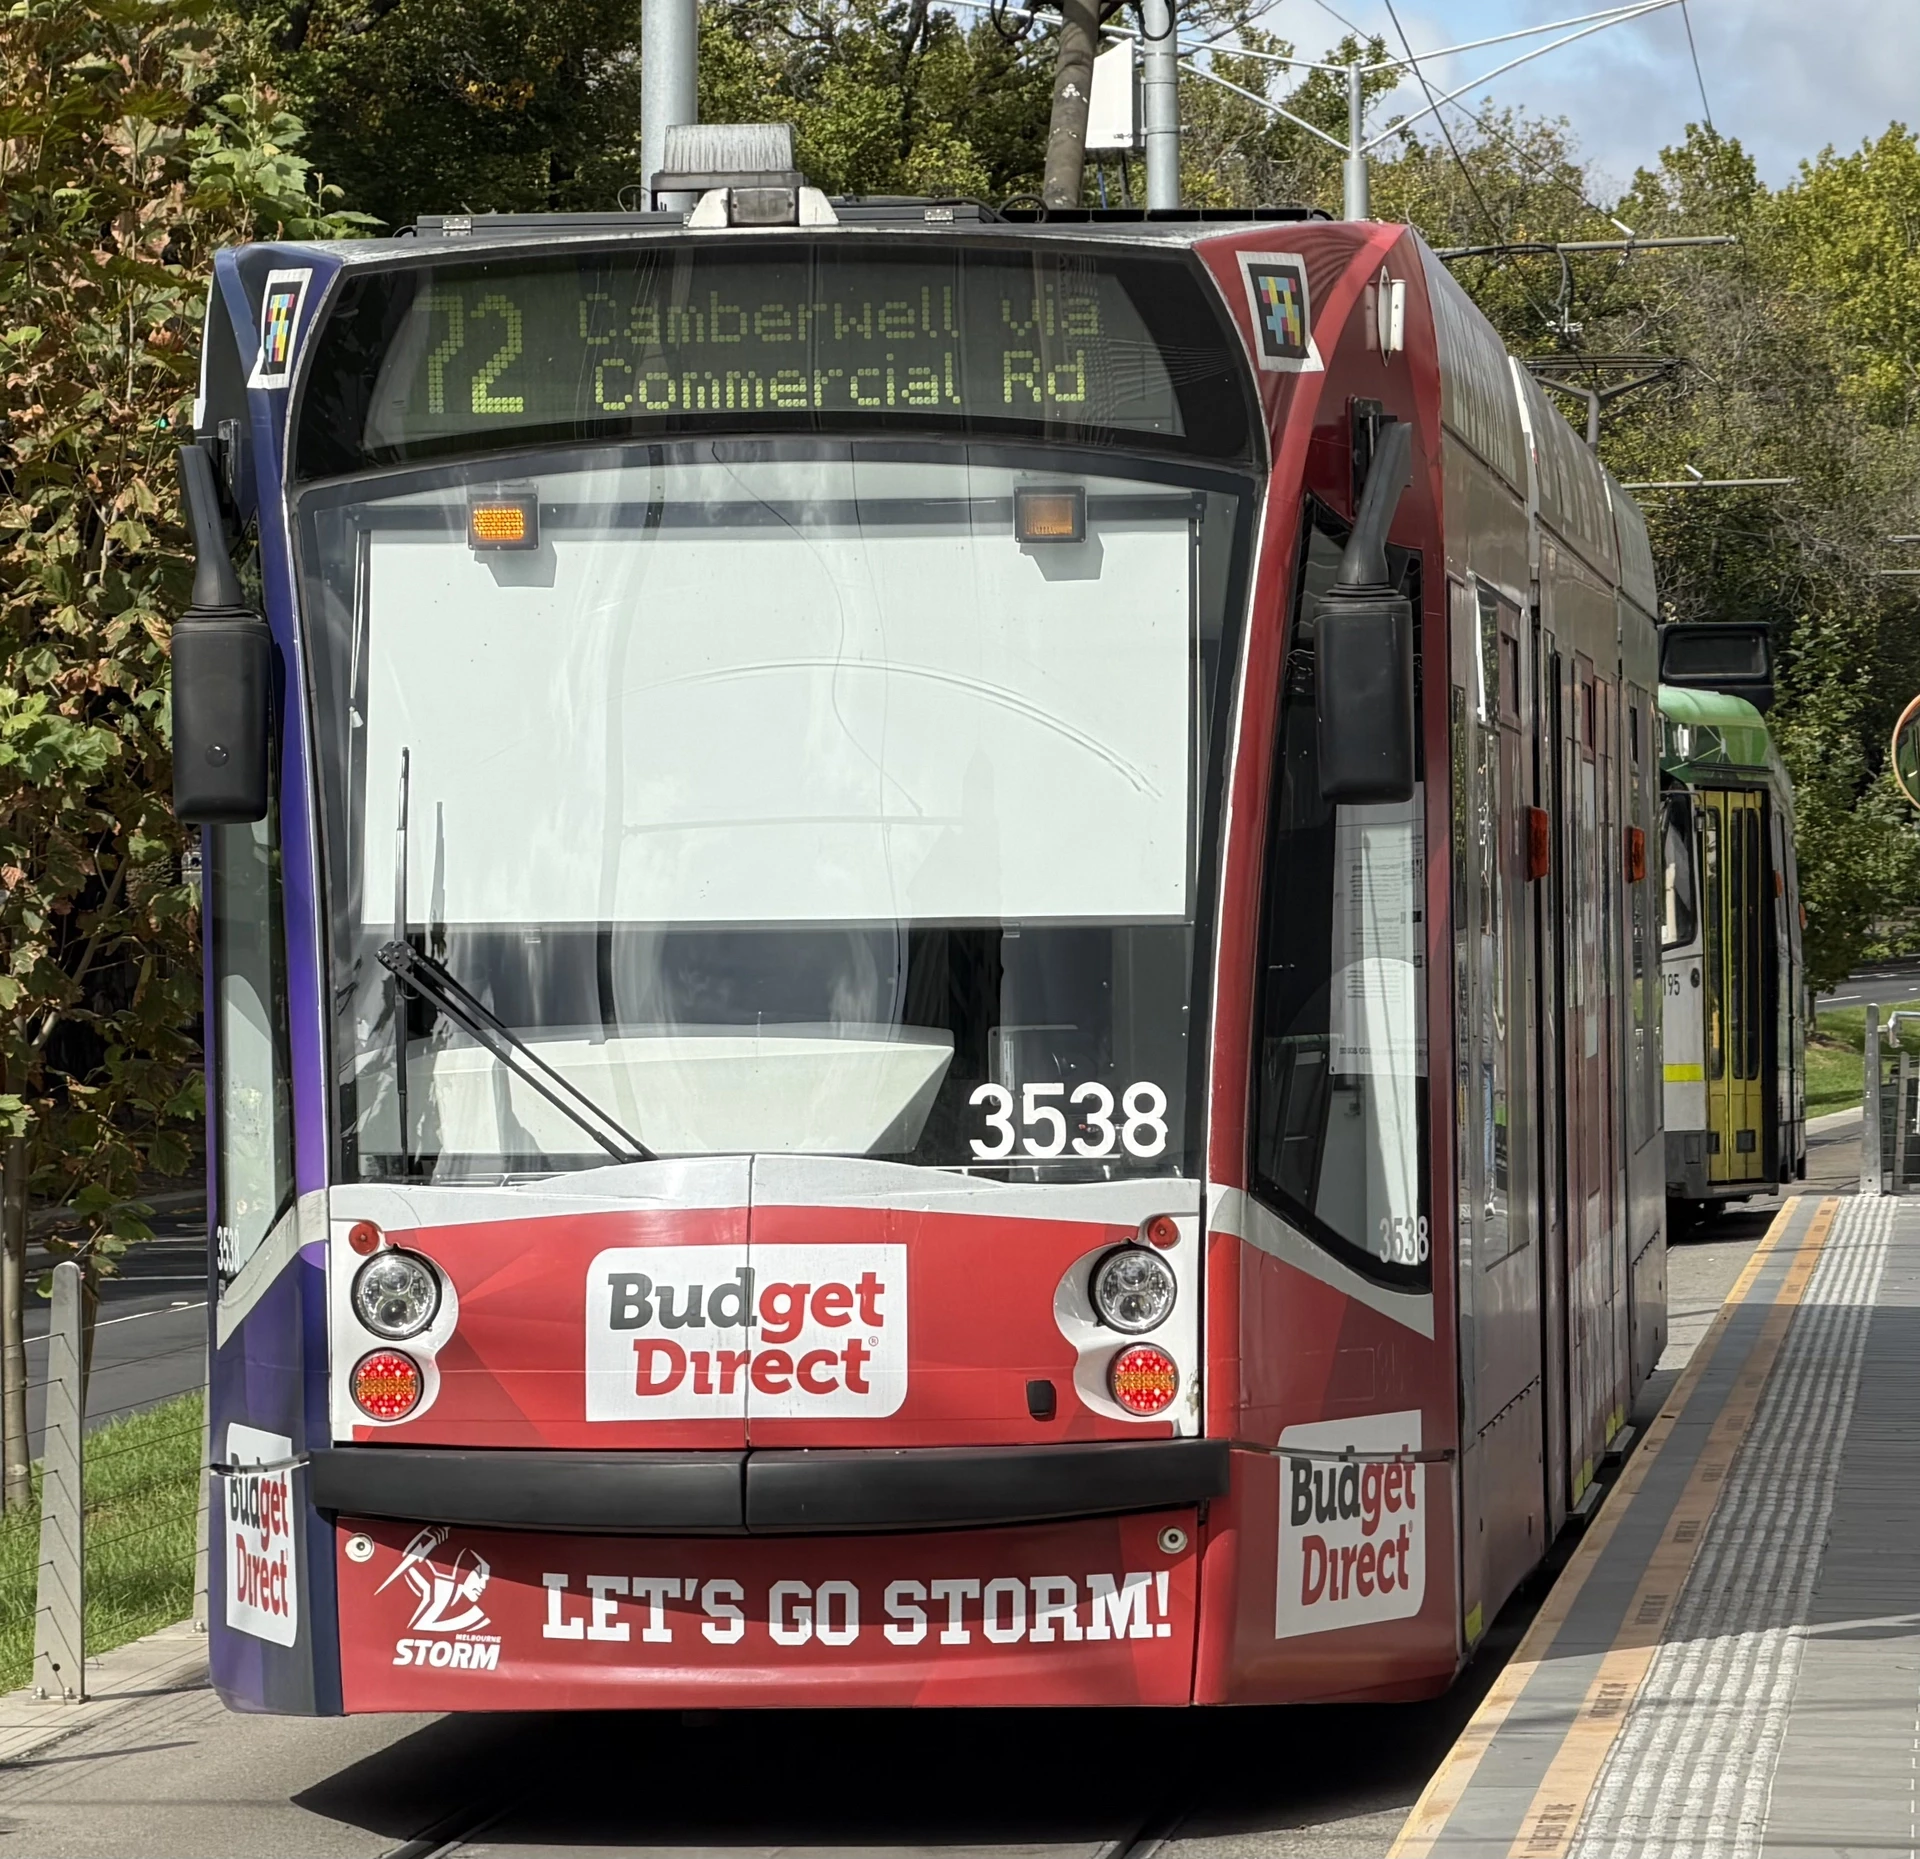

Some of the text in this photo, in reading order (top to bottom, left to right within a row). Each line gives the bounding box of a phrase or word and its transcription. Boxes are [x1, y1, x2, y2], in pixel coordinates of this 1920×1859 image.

[578, 283, 1101, 346] Camberwell via
[410, 293, 525, 415] 72
[595, 349, 1087, 412] Commercial Rd
[968, 1080, 1169, 1159] 3538
[217, 1225, 240, 1274] 3538
[1379, 1215, 1430, 1264] 3538
[607, 1266, 885, 1344] Budget
[632, 1337, 872, 1397] Direct
[230, 1452, 289, 1552] Budget
[1290, 1443, 1417, 1537] Budget
[236, 1533, 289, 1618] Direct
[1301, 1523, 1410, 1606] Direct
[455, 1633, 502, 1644] MELBOURNE
[541, 1570, 1172, 1647] LET'S GO STORM!
[392, 1637, 501, 1671] STORM
